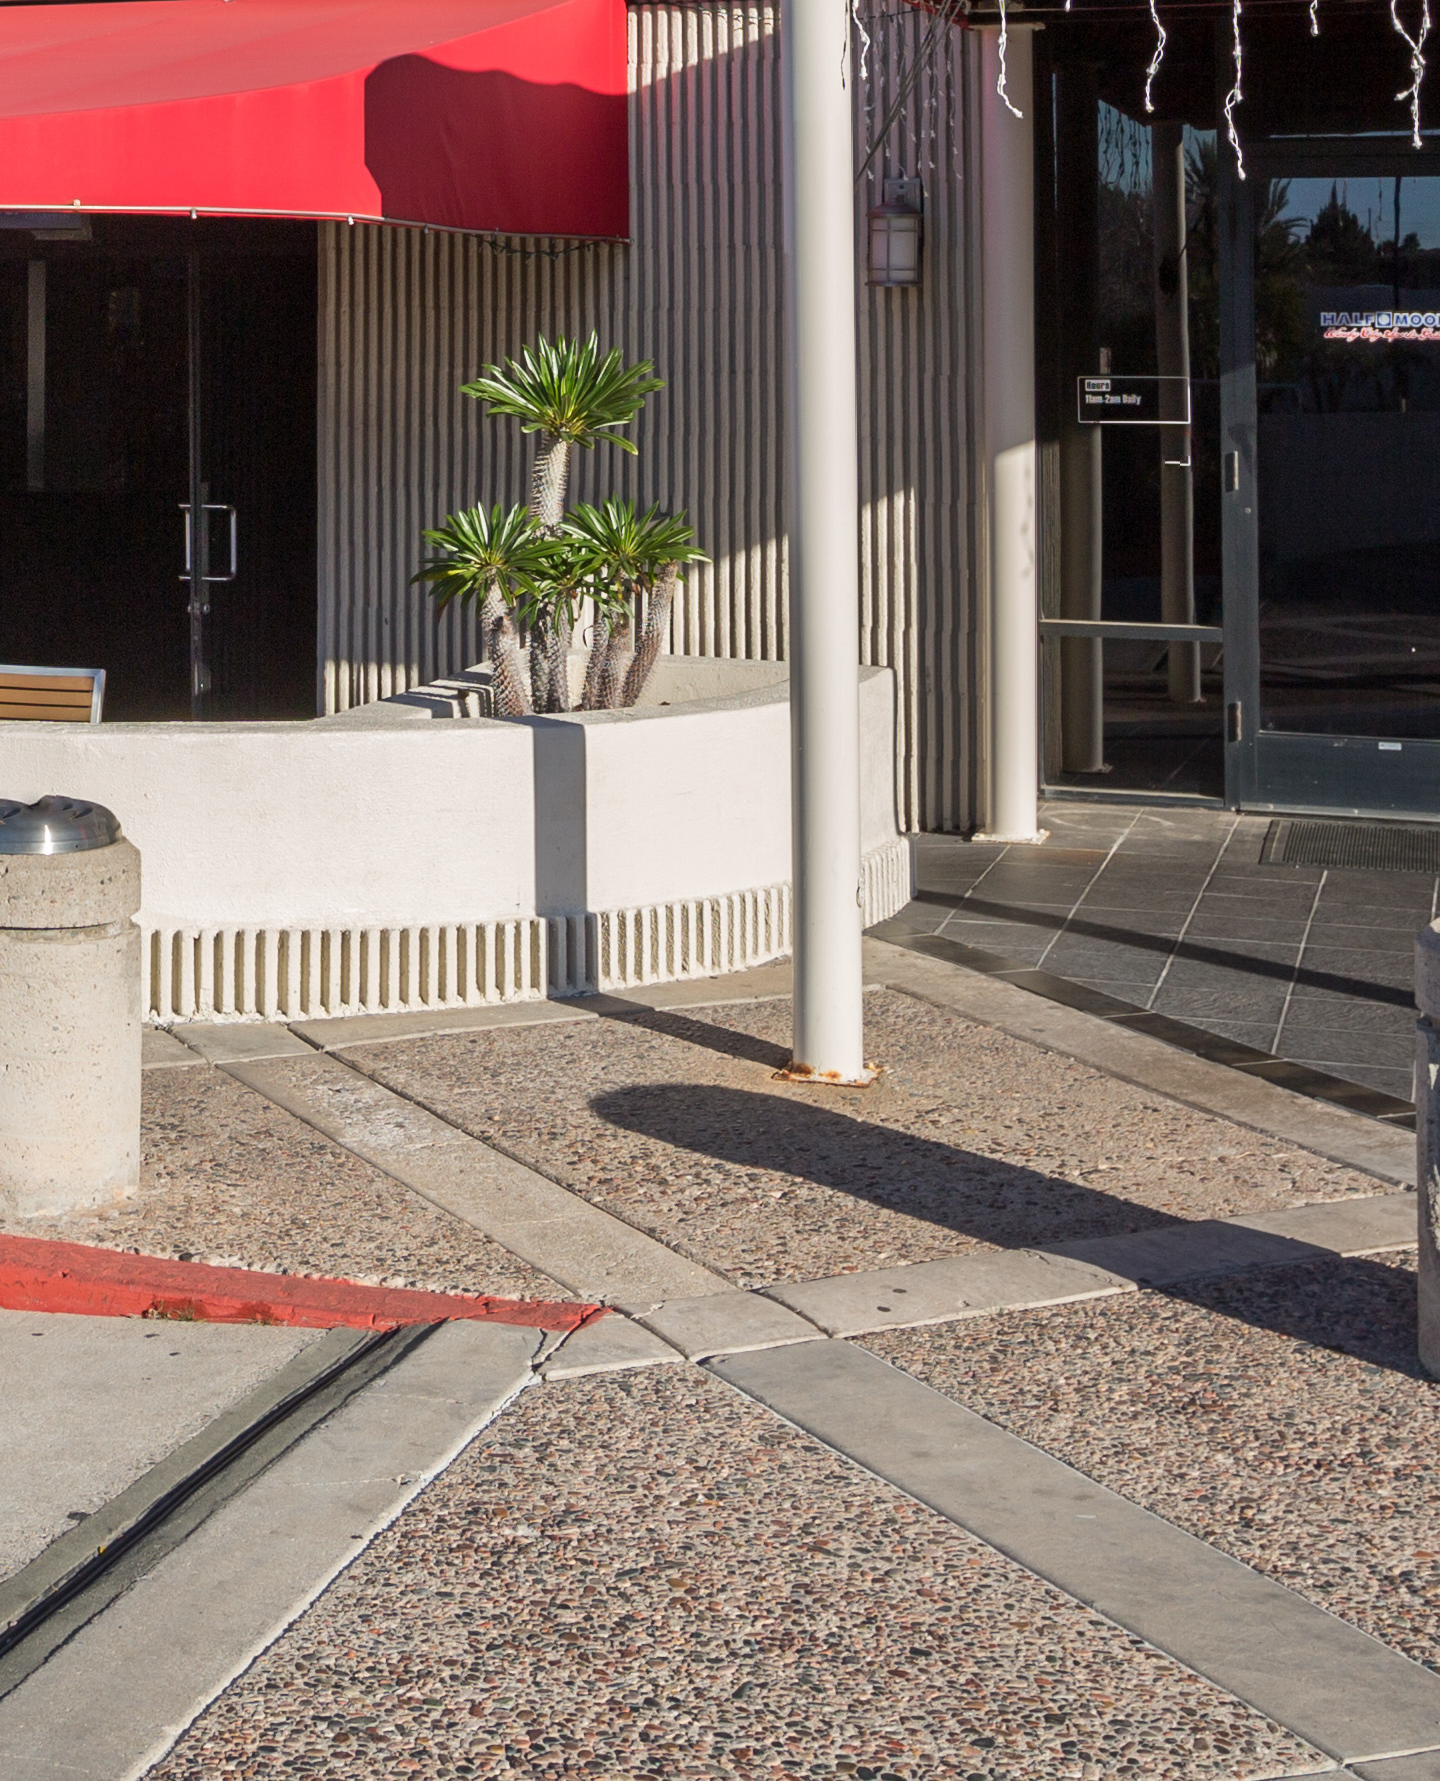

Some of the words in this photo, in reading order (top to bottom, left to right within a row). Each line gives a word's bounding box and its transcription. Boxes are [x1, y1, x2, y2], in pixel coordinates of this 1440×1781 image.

[1320, 312, 1376, 326] HALF
[1086, 381, 1110, 390] Hours
[1122, 394, 1141, 406] Daily
